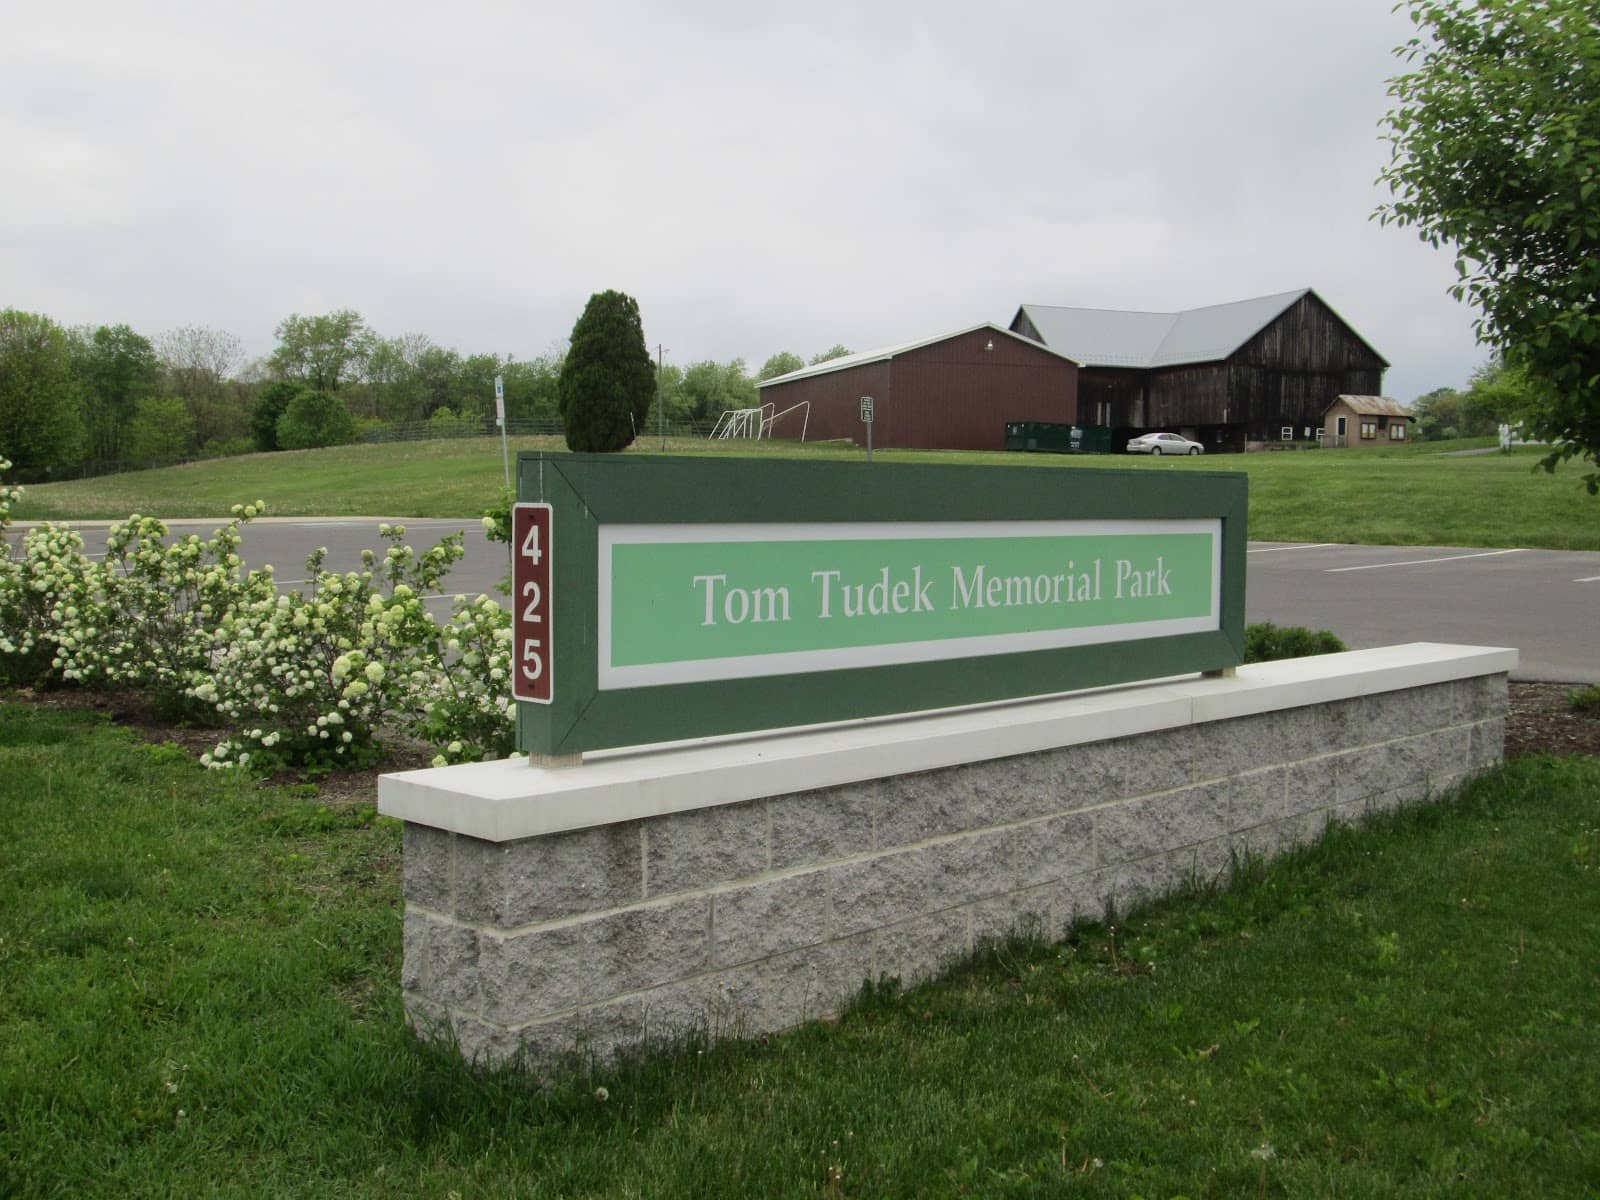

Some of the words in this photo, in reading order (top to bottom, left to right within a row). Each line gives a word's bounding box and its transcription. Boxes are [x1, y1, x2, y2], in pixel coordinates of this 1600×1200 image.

[521, 524, 543, 680] 425
[693, 574, 792, 626] Tom
[811, 565, 936, 618] Tudek
[950, 559, 1103, 610] Memorial
[1114, 556, 1172, 599] Park
